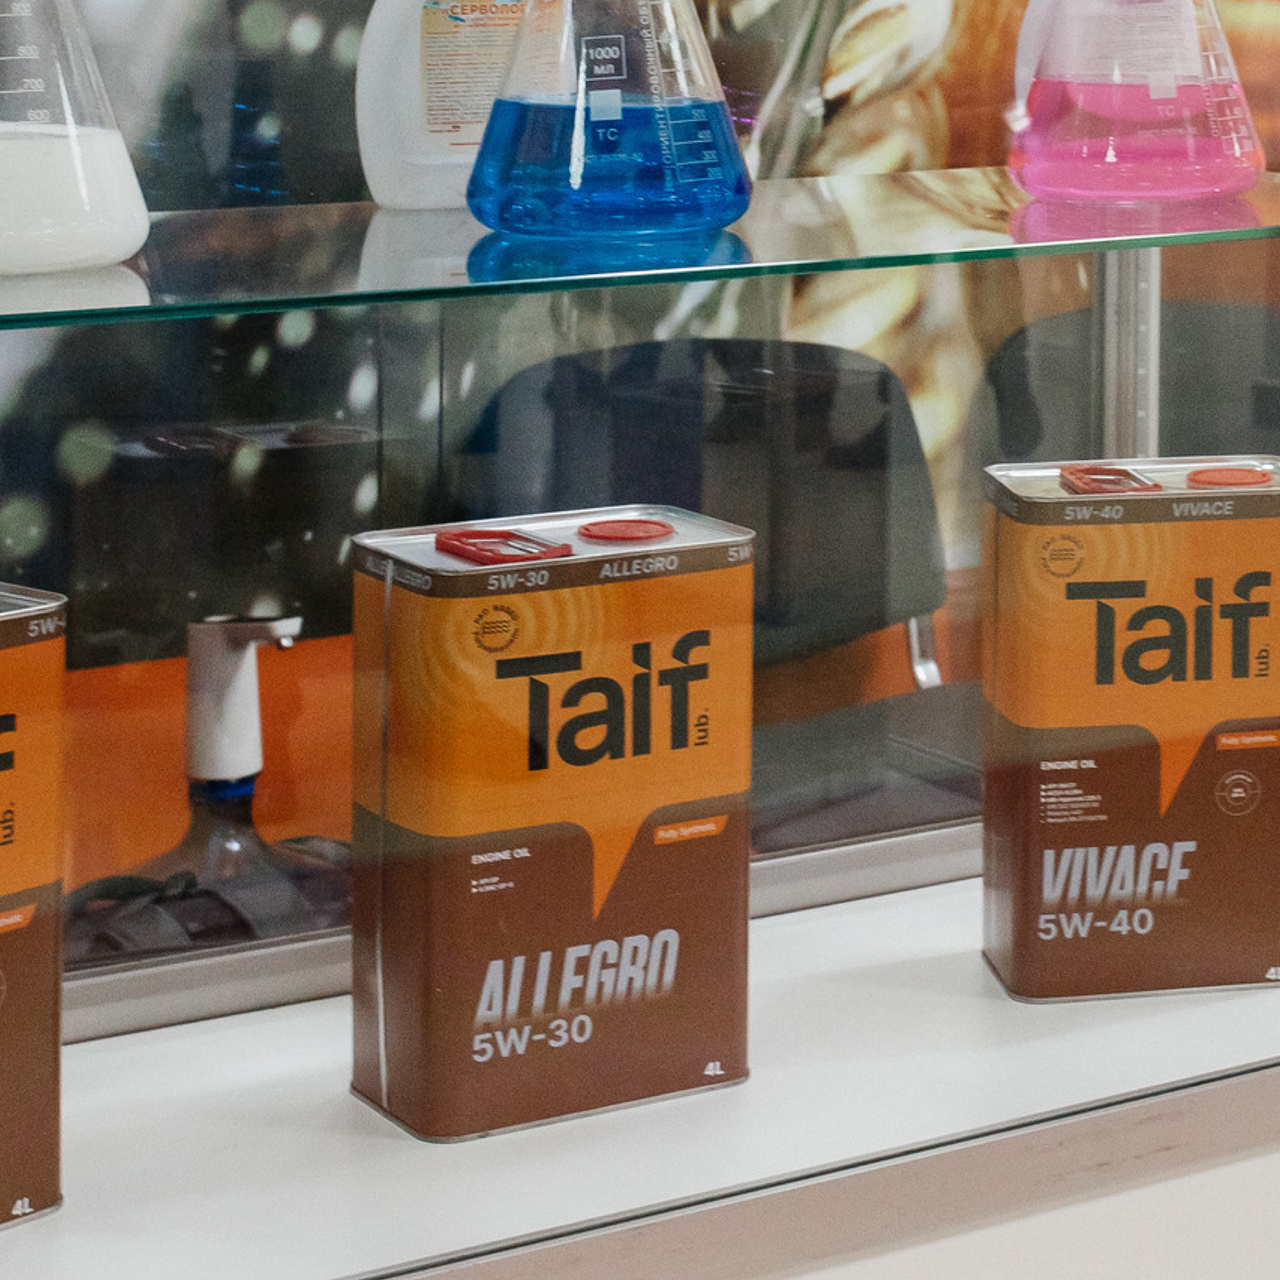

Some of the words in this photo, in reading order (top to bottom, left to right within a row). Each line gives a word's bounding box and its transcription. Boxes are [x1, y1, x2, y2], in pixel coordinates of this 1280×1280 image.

[588, 47, 620, 60] 1000
[22, 79, 45, 90] 700
[1064, 505, 1124, 520] 5W-40
[1172, 502, 1234, 517] VIVACE
[487, 570, 549, 591] 5W-30
[600, 555, 679, 578] ALLEGRO
[1066, 571, 1272, 685] Taif
[495, 630, 711, 771] Taif
[1040, 760, 1078, 770] ENGINE
[1080, 759, 1097, 769] OIL
[471, 849, 512, 865] ENGINE
[1038, 908, 1154, 940] 5W-40
[472, 1014, 593, 1063] 5W-30
[703, 1060, 725, 1076] 4L
[11, 1197, 34, 1216] 4L
